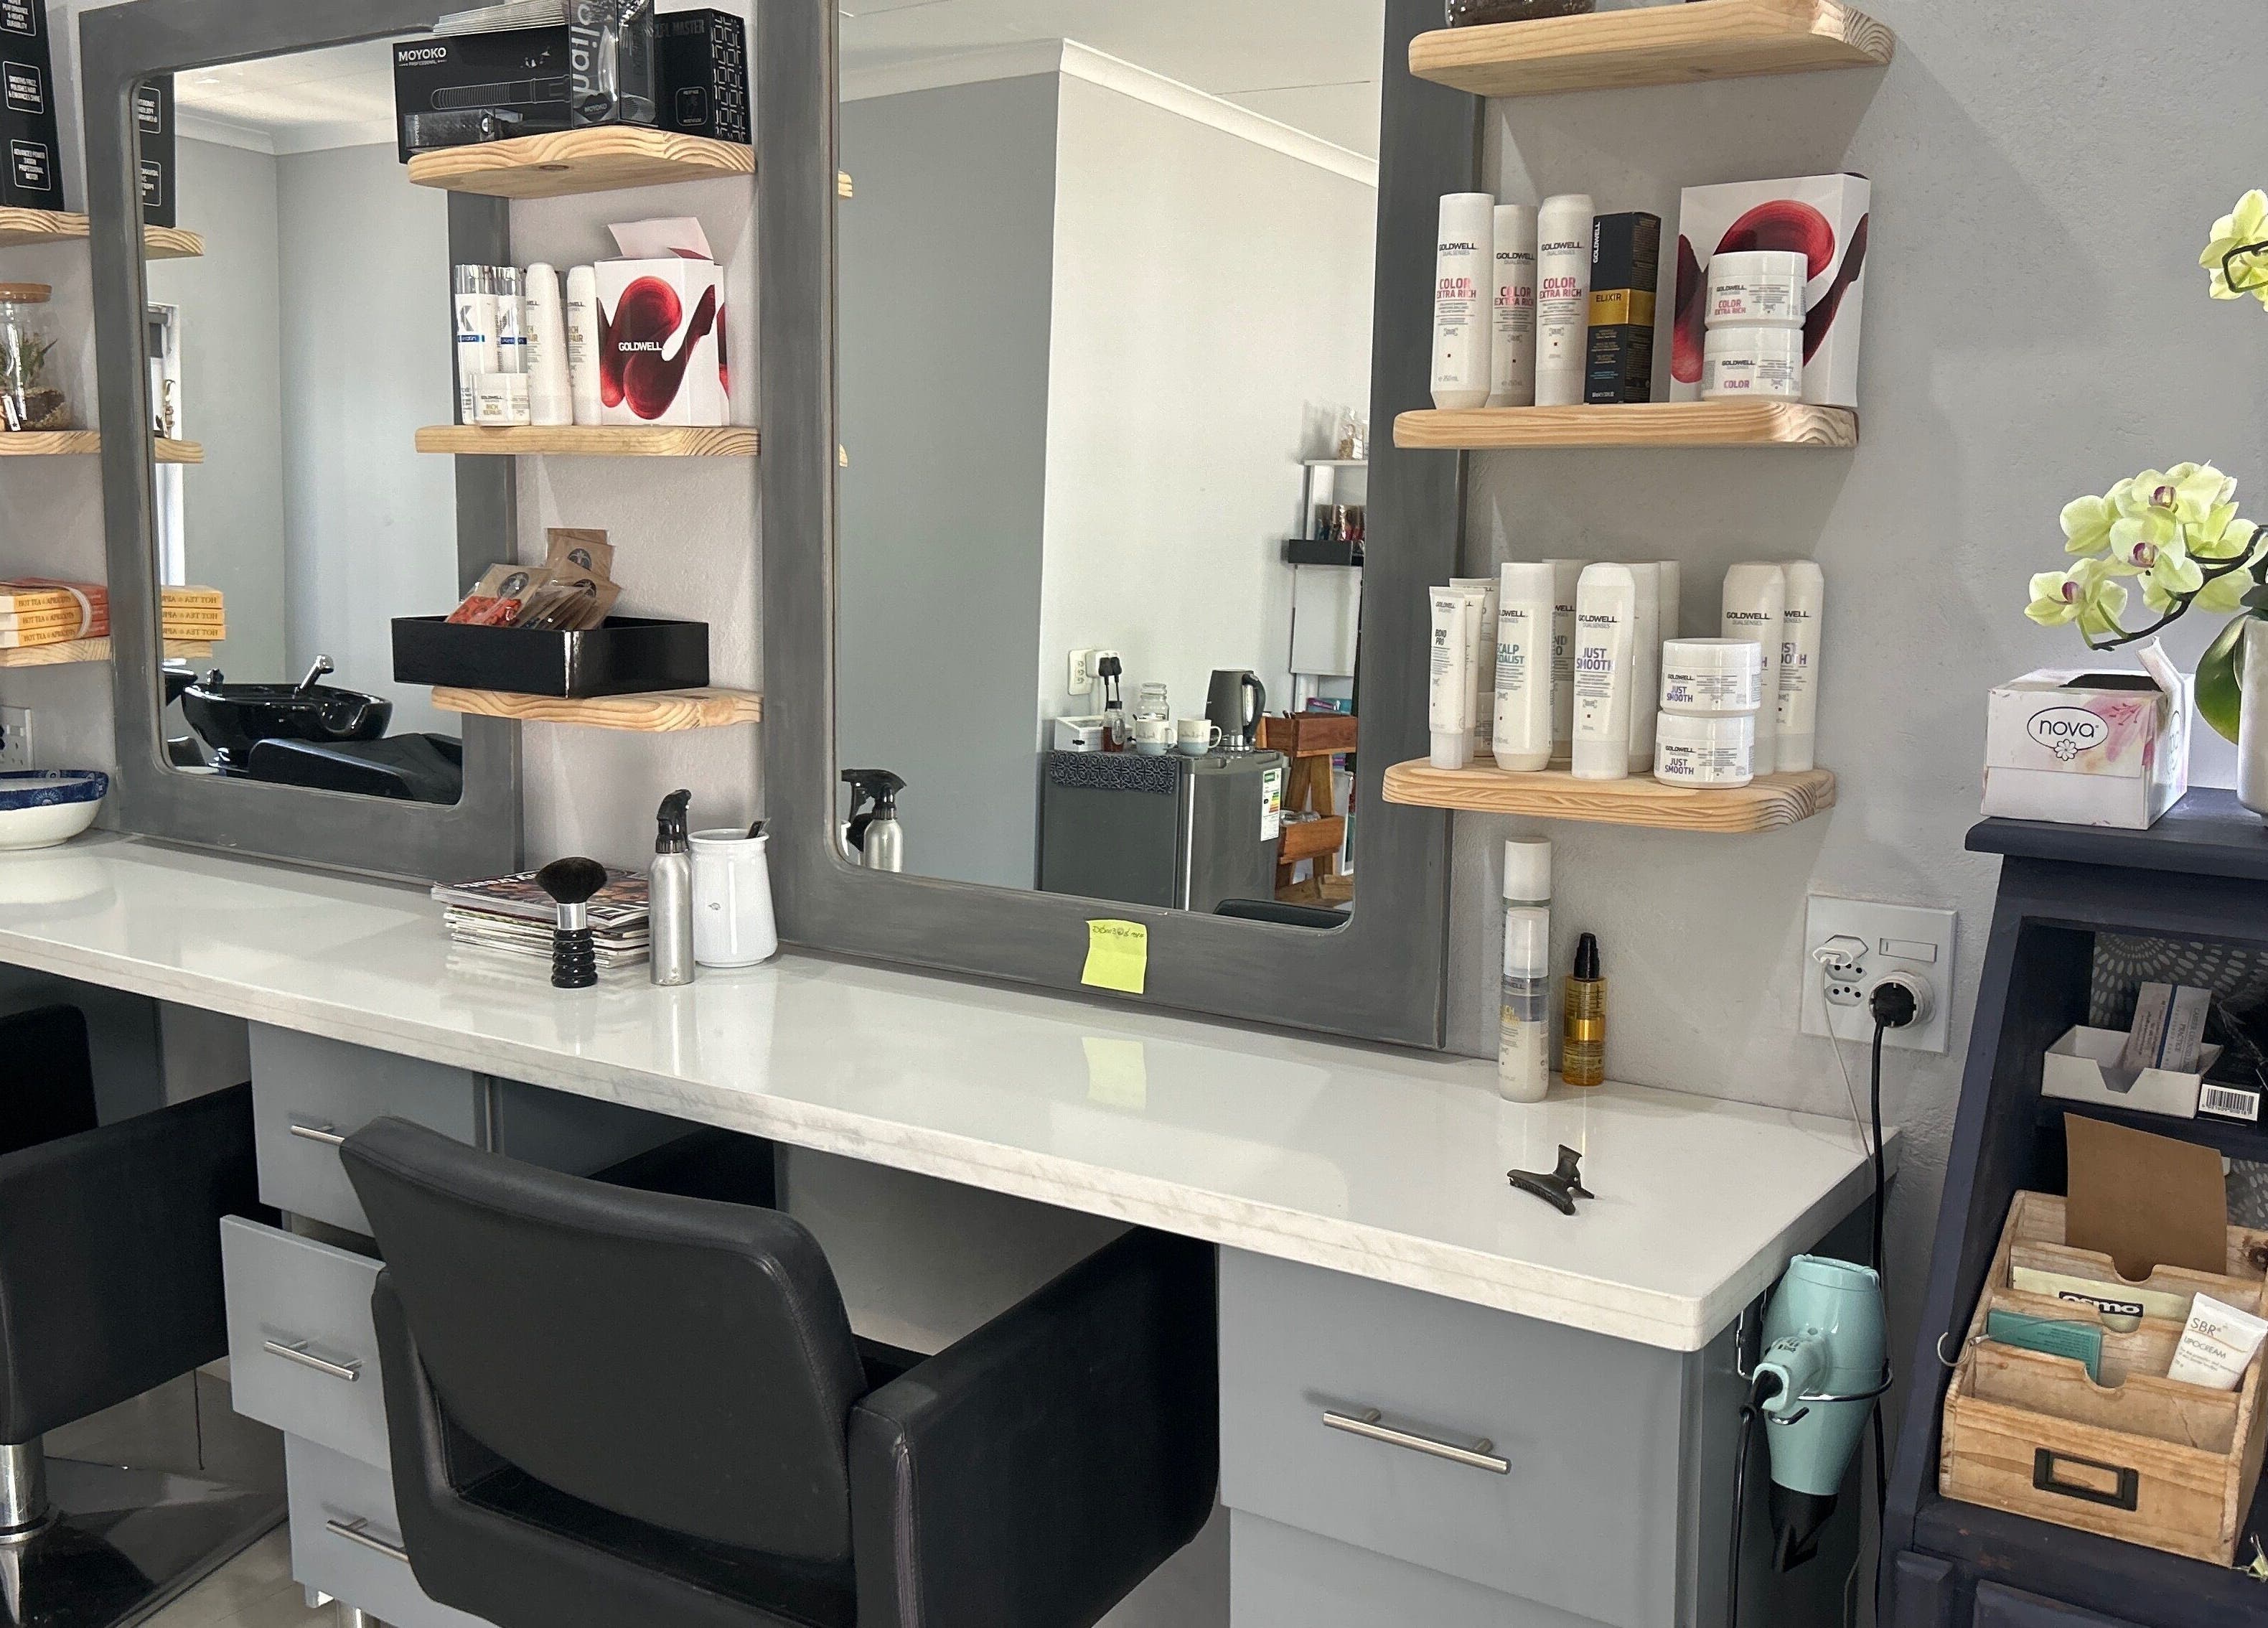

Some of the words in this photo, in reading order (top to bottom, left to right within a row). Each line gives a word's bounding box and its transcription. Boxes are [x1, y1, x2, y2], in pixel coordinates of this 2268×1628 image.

[398, 47, 447, 62] MOYOKO
[1439, 243, 1479, 251] GOLDWELL
[1542, 241, 1584, 251] GOLDWELL
[1496, 252, 1536, 261] GOLDWELL
[1440, 278, 1471, 289] COLOR
[1543, 277, 1576, 289] COLOR
[1436, 290, 1456, 299] EXTRA
[1500, 286, 1532, 297] COLOR
[1540, 289, 1560, 299] EXTRA
[1562, 289, 1582, 297] RICH
[1595, 293, 1621, 302] ELIXIR
[1719, 299, 1742, 308] COLOR
[619, 342, 662, 352] GOLDWELL
[1724, 380, 1750, 389] COLOR
[1584, 647, 1607, 659] JUST
[1667, 693, 1693, 702] SMOOTH
[2039, 720, 2094, 738] nova
[1665, 765, 1694, 775] SMOOTH
[2190, 1317, 2216, 1336] SBR
